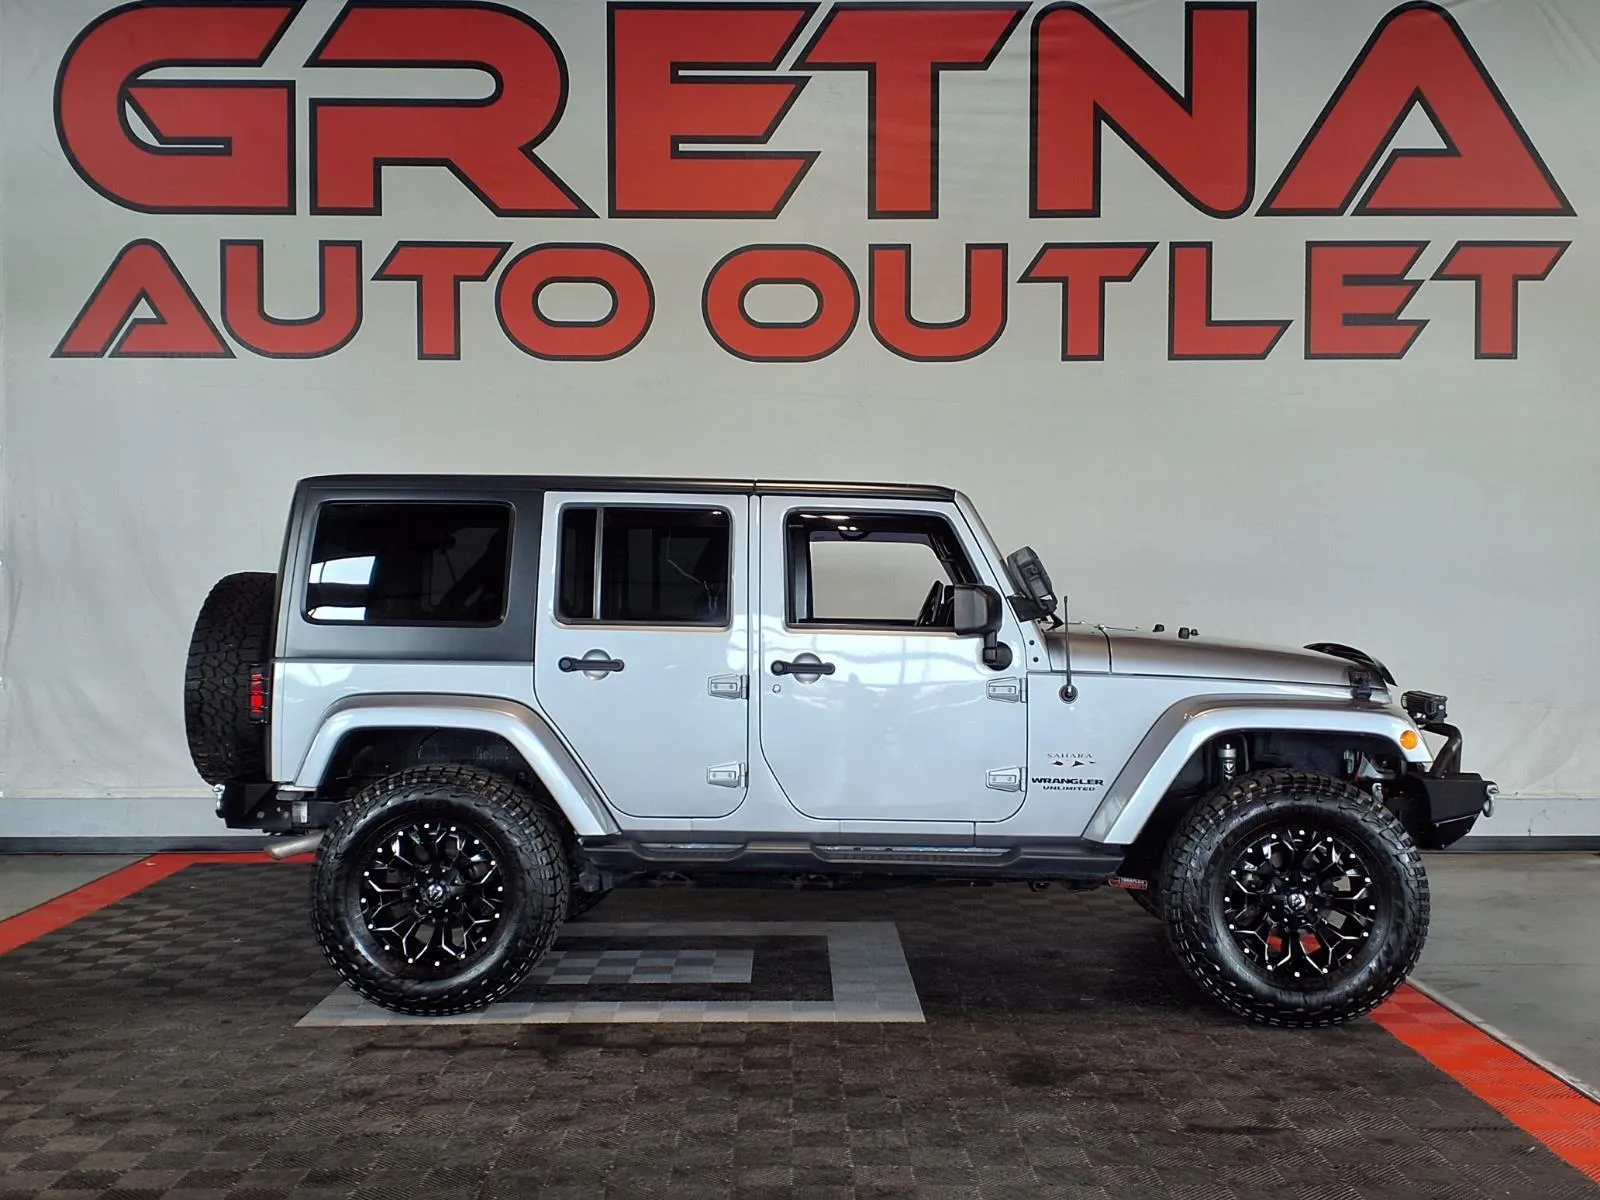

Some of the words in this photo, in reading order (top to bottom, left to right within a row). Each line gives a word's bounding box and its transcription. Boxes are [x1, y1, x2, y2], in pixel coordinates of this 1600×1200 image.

[53, 0, 1577, 219] GRETNA
[51, 239, 655, 361] AUTO
[702, 241, 1572, 362] OUTLET
[1031, 777, 1104, 786] WRANGLER
